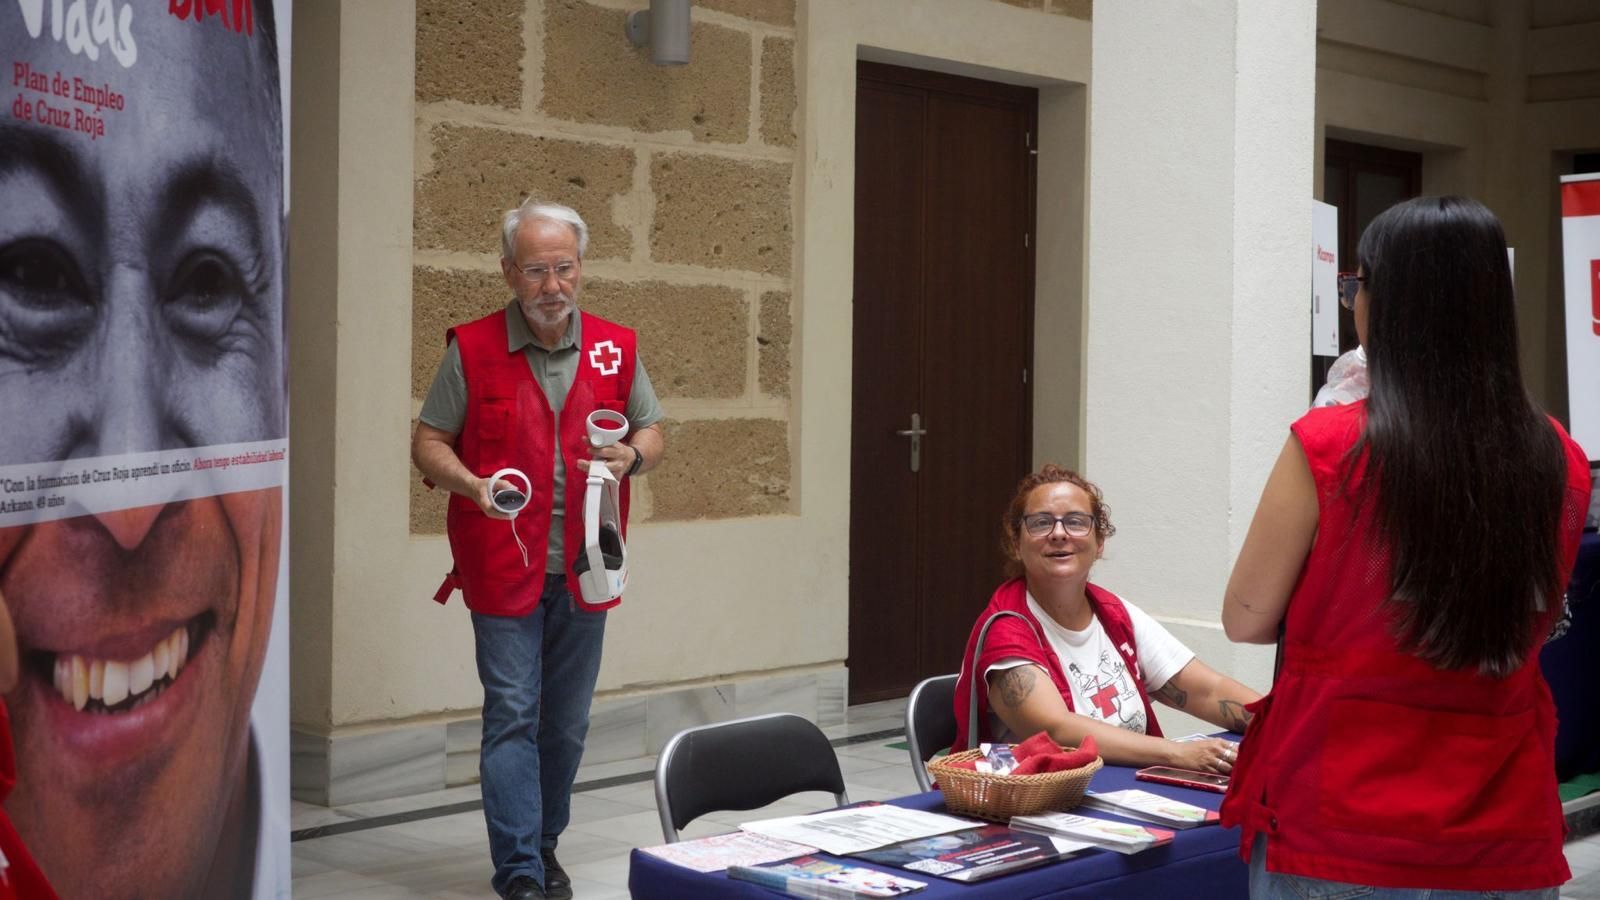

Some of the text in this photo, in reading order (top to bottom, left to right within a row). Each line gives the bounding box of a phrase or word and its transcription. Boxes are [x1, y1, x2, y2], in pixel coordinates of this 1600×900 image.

[12, 62, 125, 112] Plan de Empleo
[13, 92, 105, 140] de Cruz Roja
[26, 475, 35, 491] la
[81, 469, 91, 485] de
[92, 469, 111, 483] Cruz
[112, 467, 129, 482] Roja
[160, 464, 170, 475] un
[193, 457, 212, 471] Ahora
